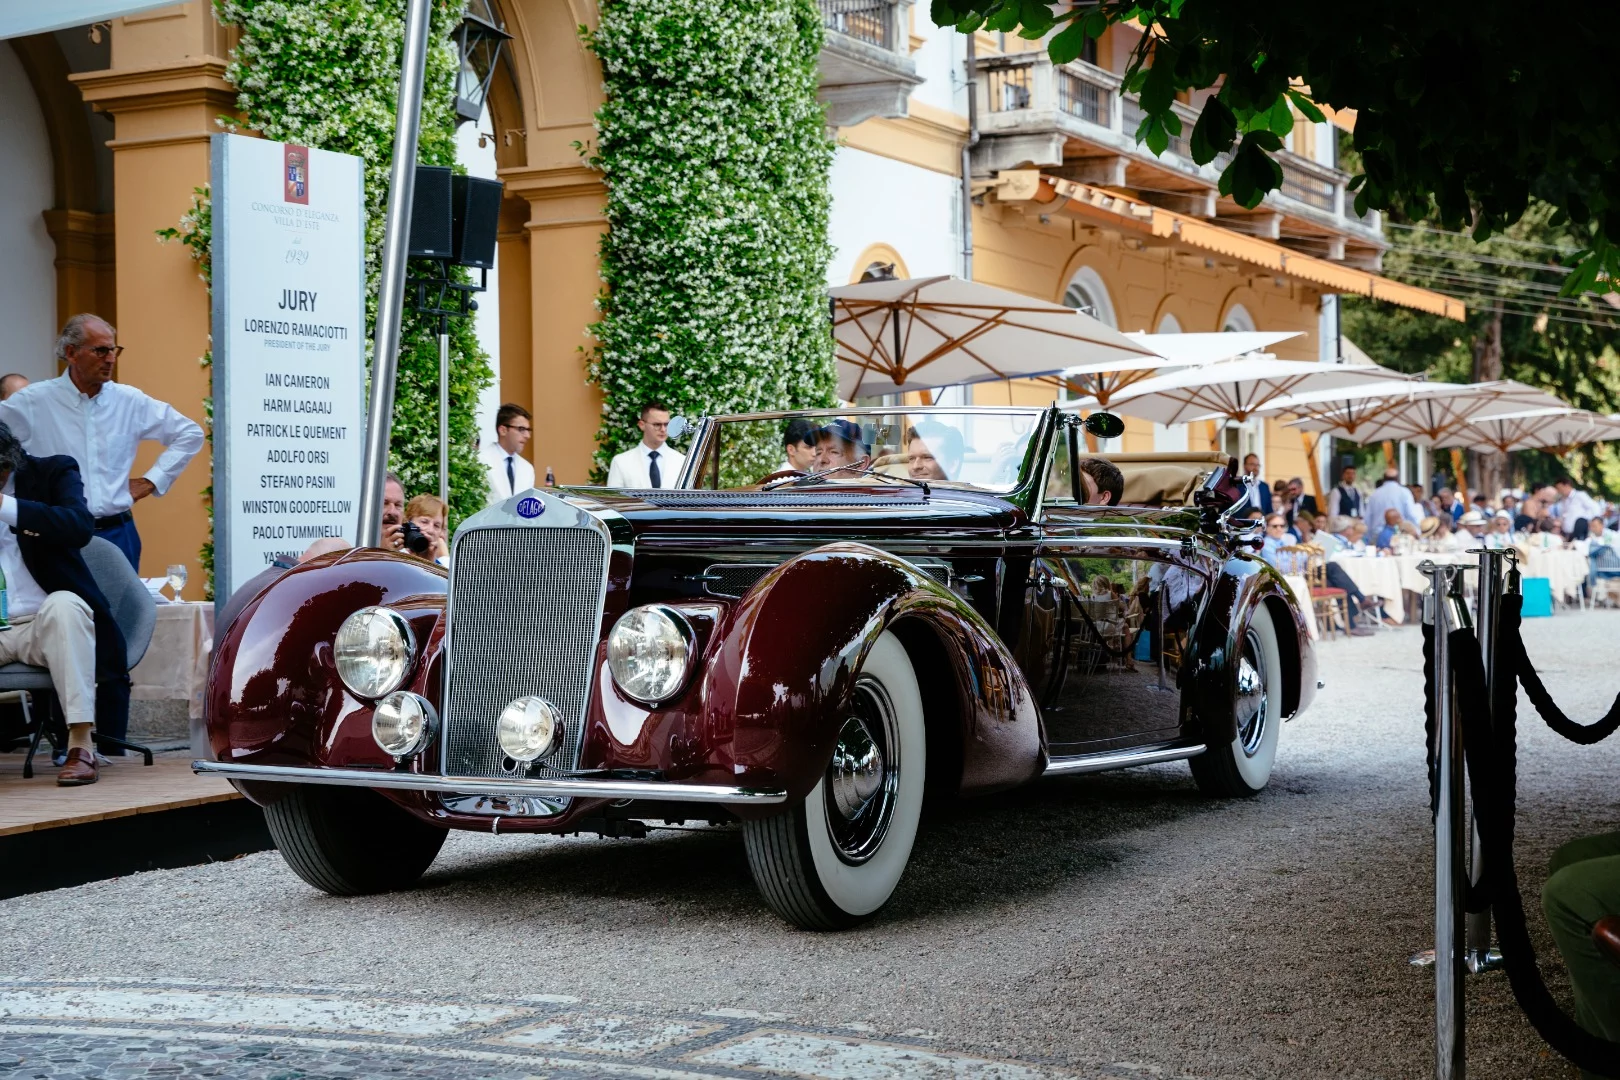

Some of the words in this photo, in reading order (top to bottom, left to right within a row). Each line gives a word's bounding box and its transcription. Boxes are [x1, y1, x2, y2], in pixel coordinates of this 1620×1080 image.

[251, 202, 294, 215] CONCORSO
[274, 216, 294, 226] VILLA
[285, 249, 309, 266] 1929
[278, 288, 318, 313] JURY
[244, 318, 290, 336] LORENZO
[291, 322, 348, 340] RAMACIOTTI
[264, 340, 296, 349] PRESIDENT
[296, 341, 305, 350] OF
[305, 342, 316, 351] THE
[265, 373, 282, 386] IAN
[283, 374, 330, 390] CAMERON
[263, 399, 292, 412] HARM
[293, 399, 332, 415] LAGAAIJ
[247, 423, 289, 438] PATRICK
[289, 425, 301, 438] LE
[302, 425, 347, 440] QUEMENT
[267, 449, 306, 464] ADOLFO
[307, 450, 329, 464] ORSI
[260, 475, 304, 489] STEFANO
[305, 475, 336, 489] PASINI
[242, 500, 287, 514] WINSTON
[289, 500, 352, 514] GOODFELLOW
[253, 525, 285, 540] PAOLO
[286, 525, 343, 539] TUMMINELLI
